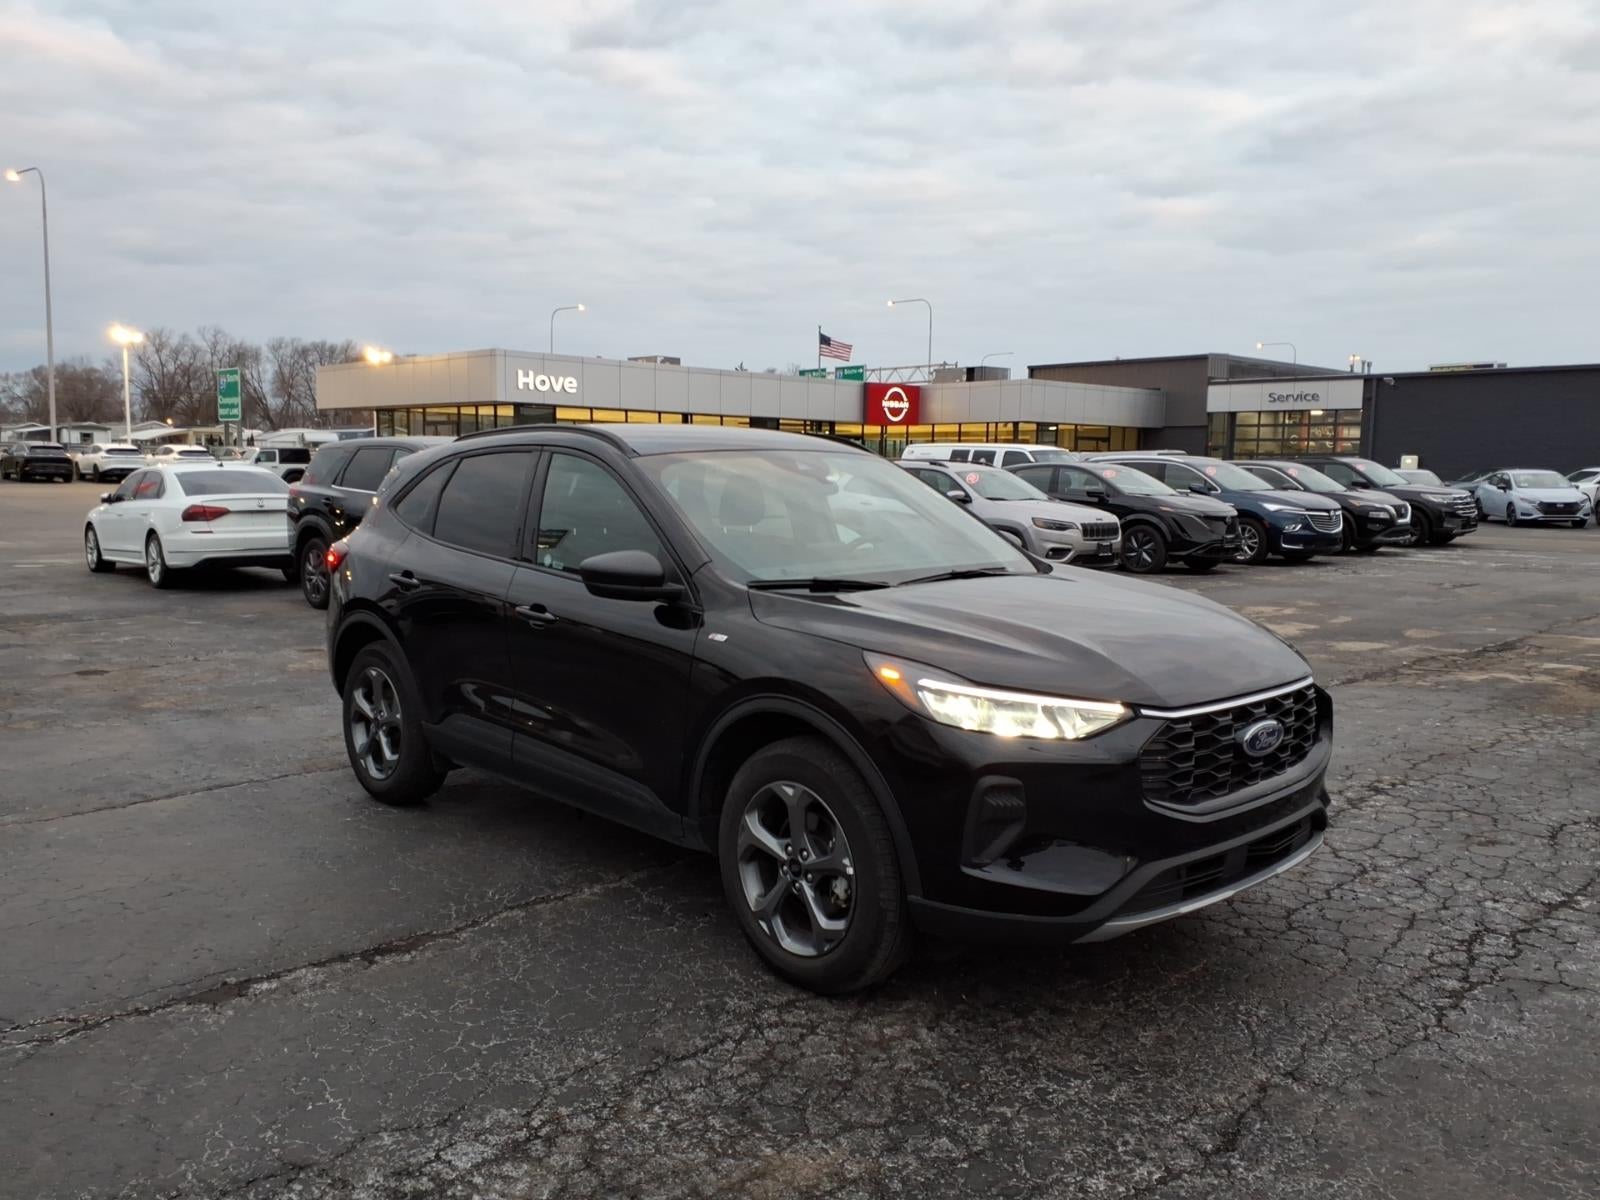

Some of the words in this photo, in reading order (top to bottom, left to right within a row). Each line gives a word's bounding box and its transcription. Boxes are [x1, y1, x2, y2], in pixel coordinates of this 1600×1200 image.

[517, 369, 578, 394] Hove
[1268, 390, 1320, 403] Service
[881, 399, 909, 409] NISSAN
